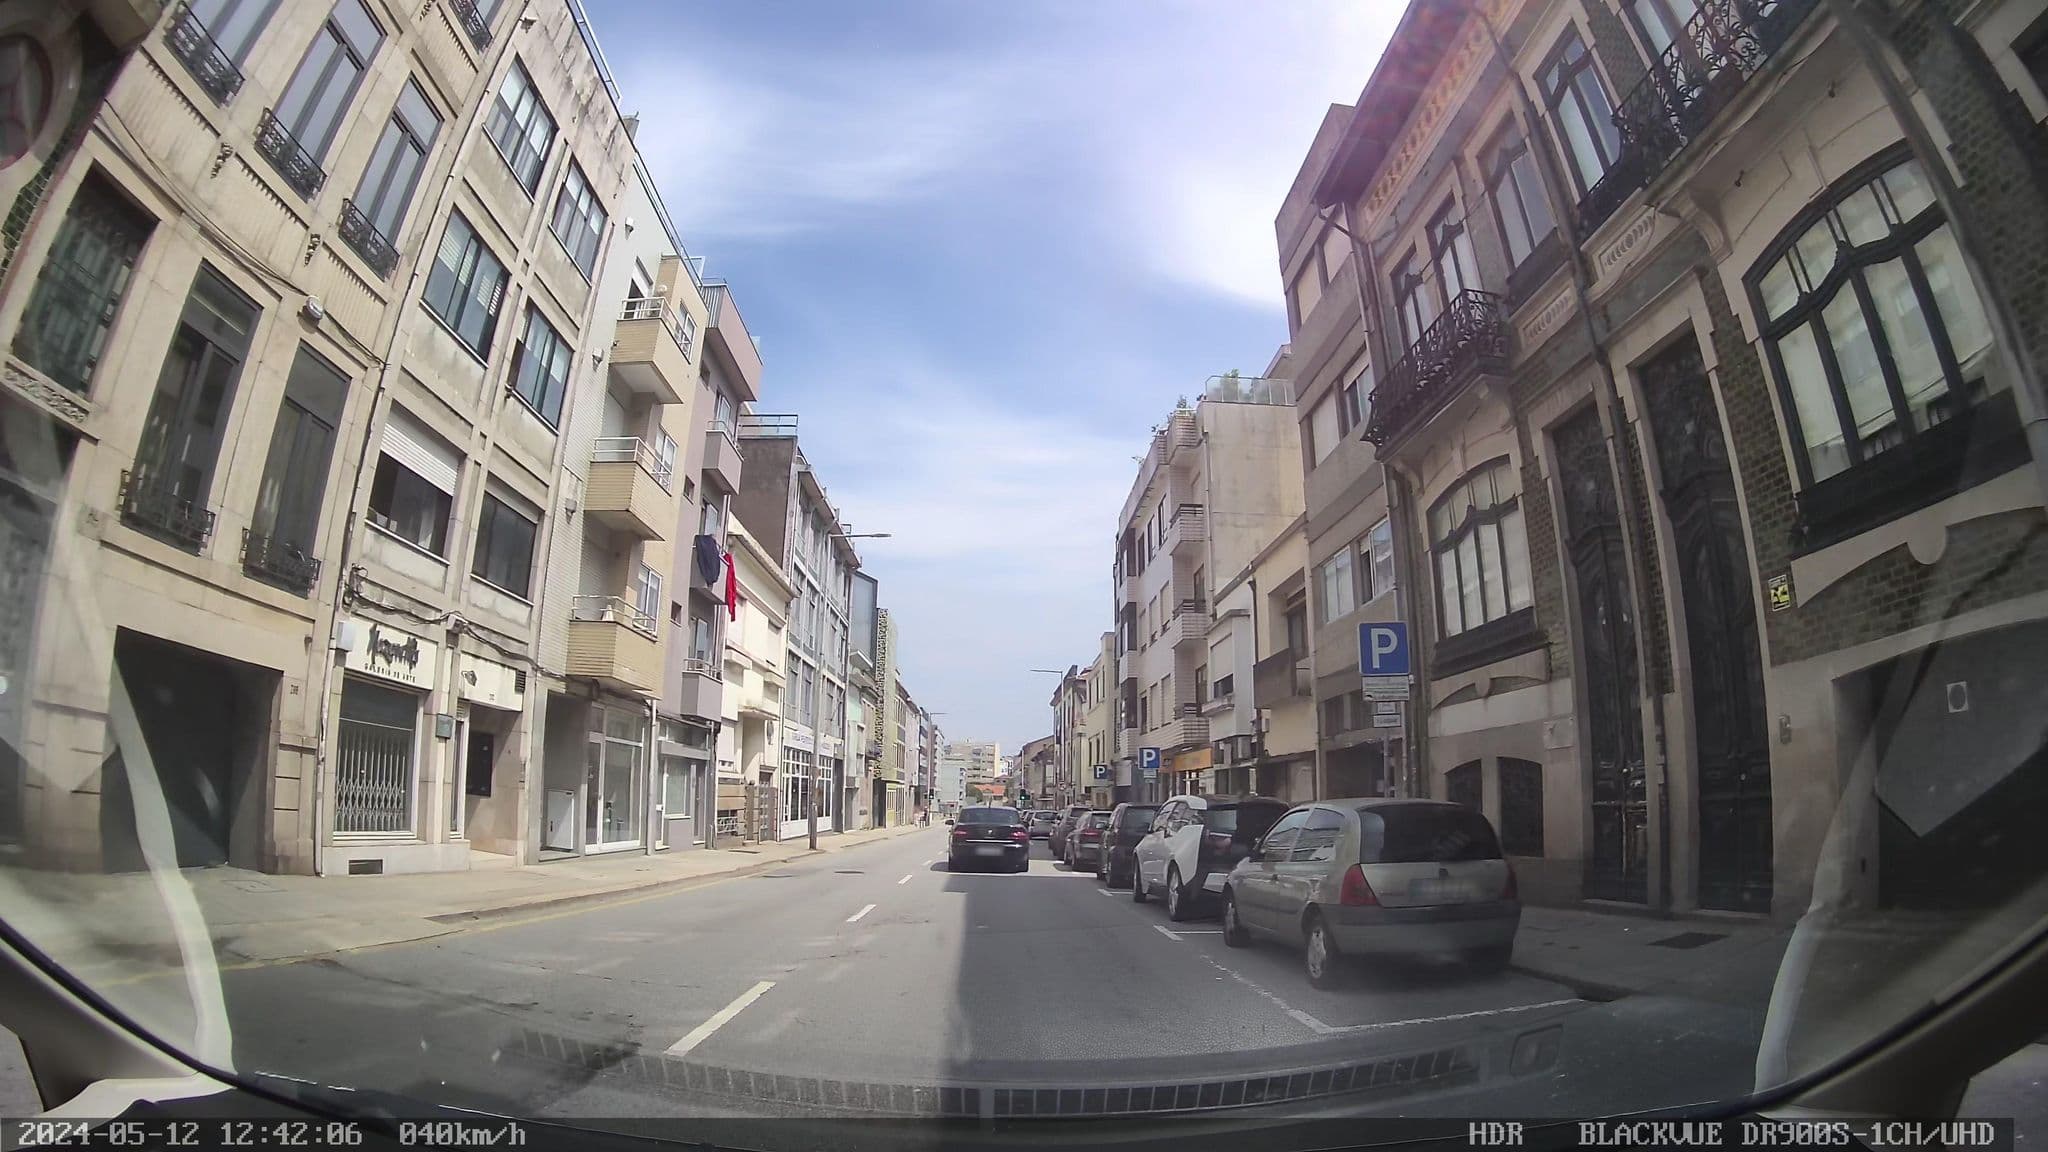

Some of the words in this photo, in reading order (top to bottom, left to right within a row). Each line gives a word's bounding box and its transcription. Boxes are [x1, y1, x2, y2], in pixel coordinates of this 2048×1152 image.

[1370, 628, 1398, 669] P
[1142, 749, 1156, 768] P
[1095, 765, 1106, 778] P
